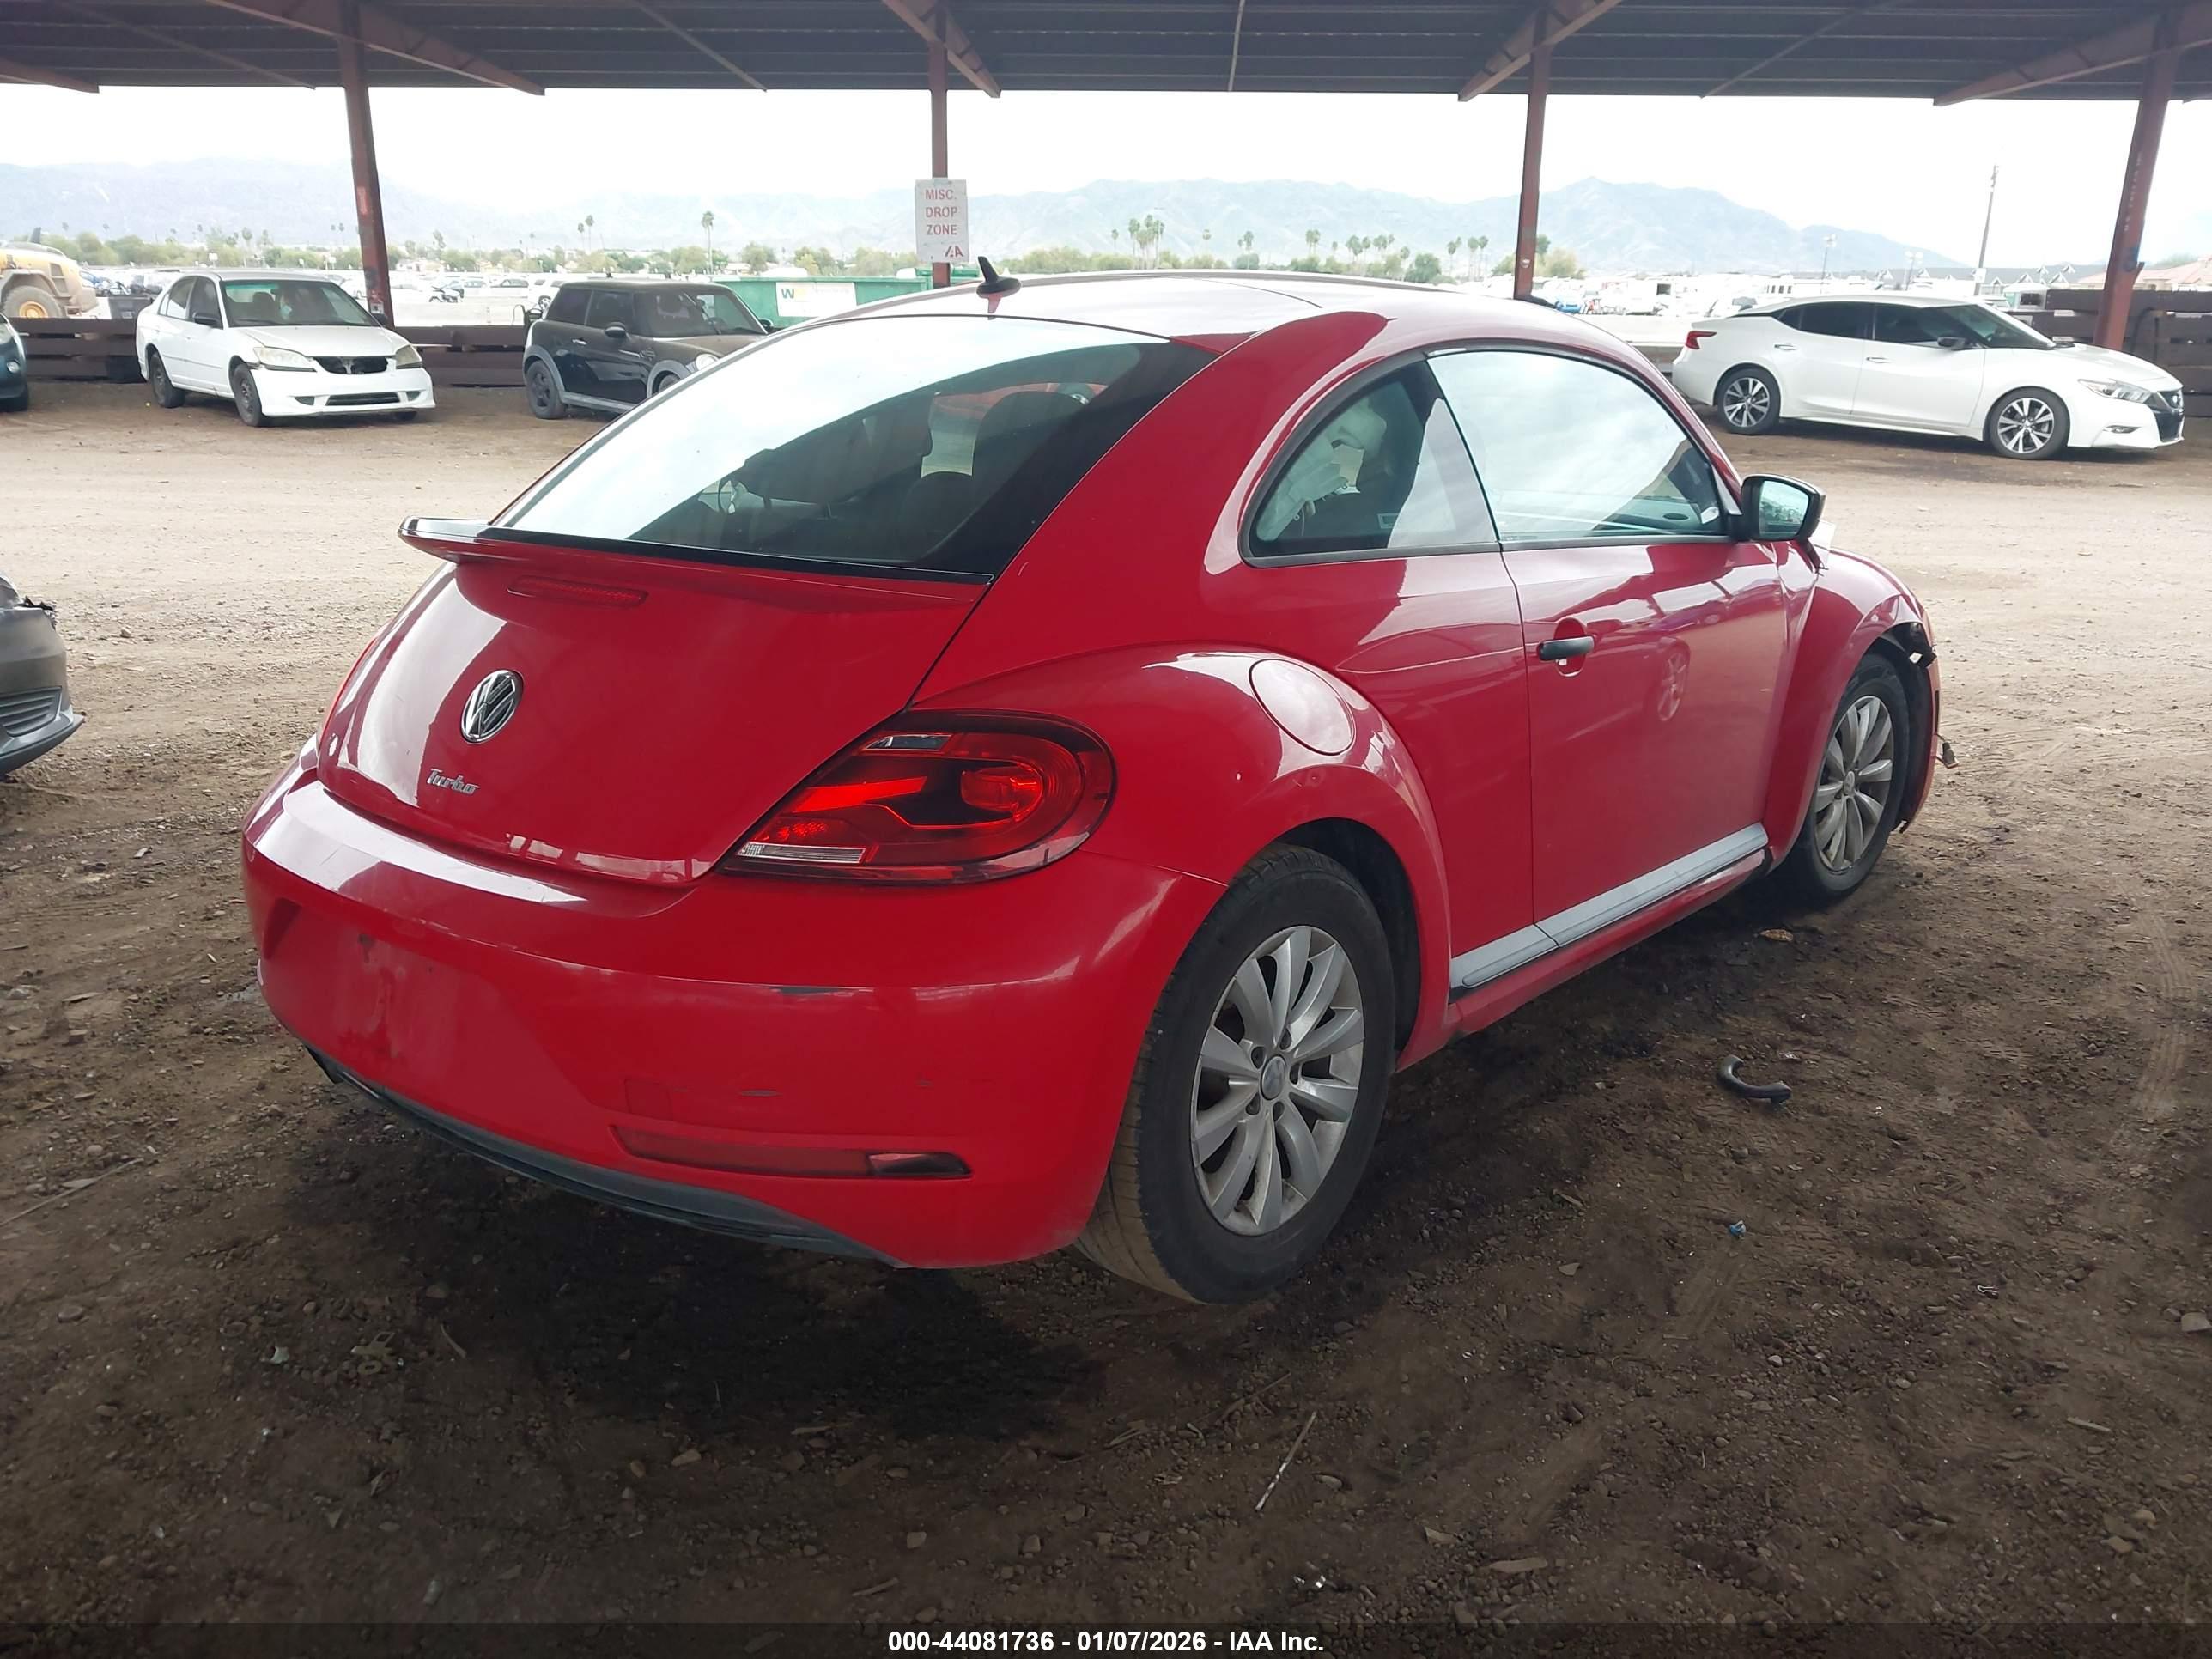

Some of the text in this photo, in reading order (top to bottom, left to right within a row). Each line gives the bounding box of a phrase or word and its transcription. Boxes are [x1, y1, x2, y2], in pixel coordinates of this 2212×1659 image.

[925, 189, 957, 200] MISC.
[926, 206, 958, 218] DROP
[927, 224, 958, 235] ZONE
[426, 768, 480, 794] Turbo
